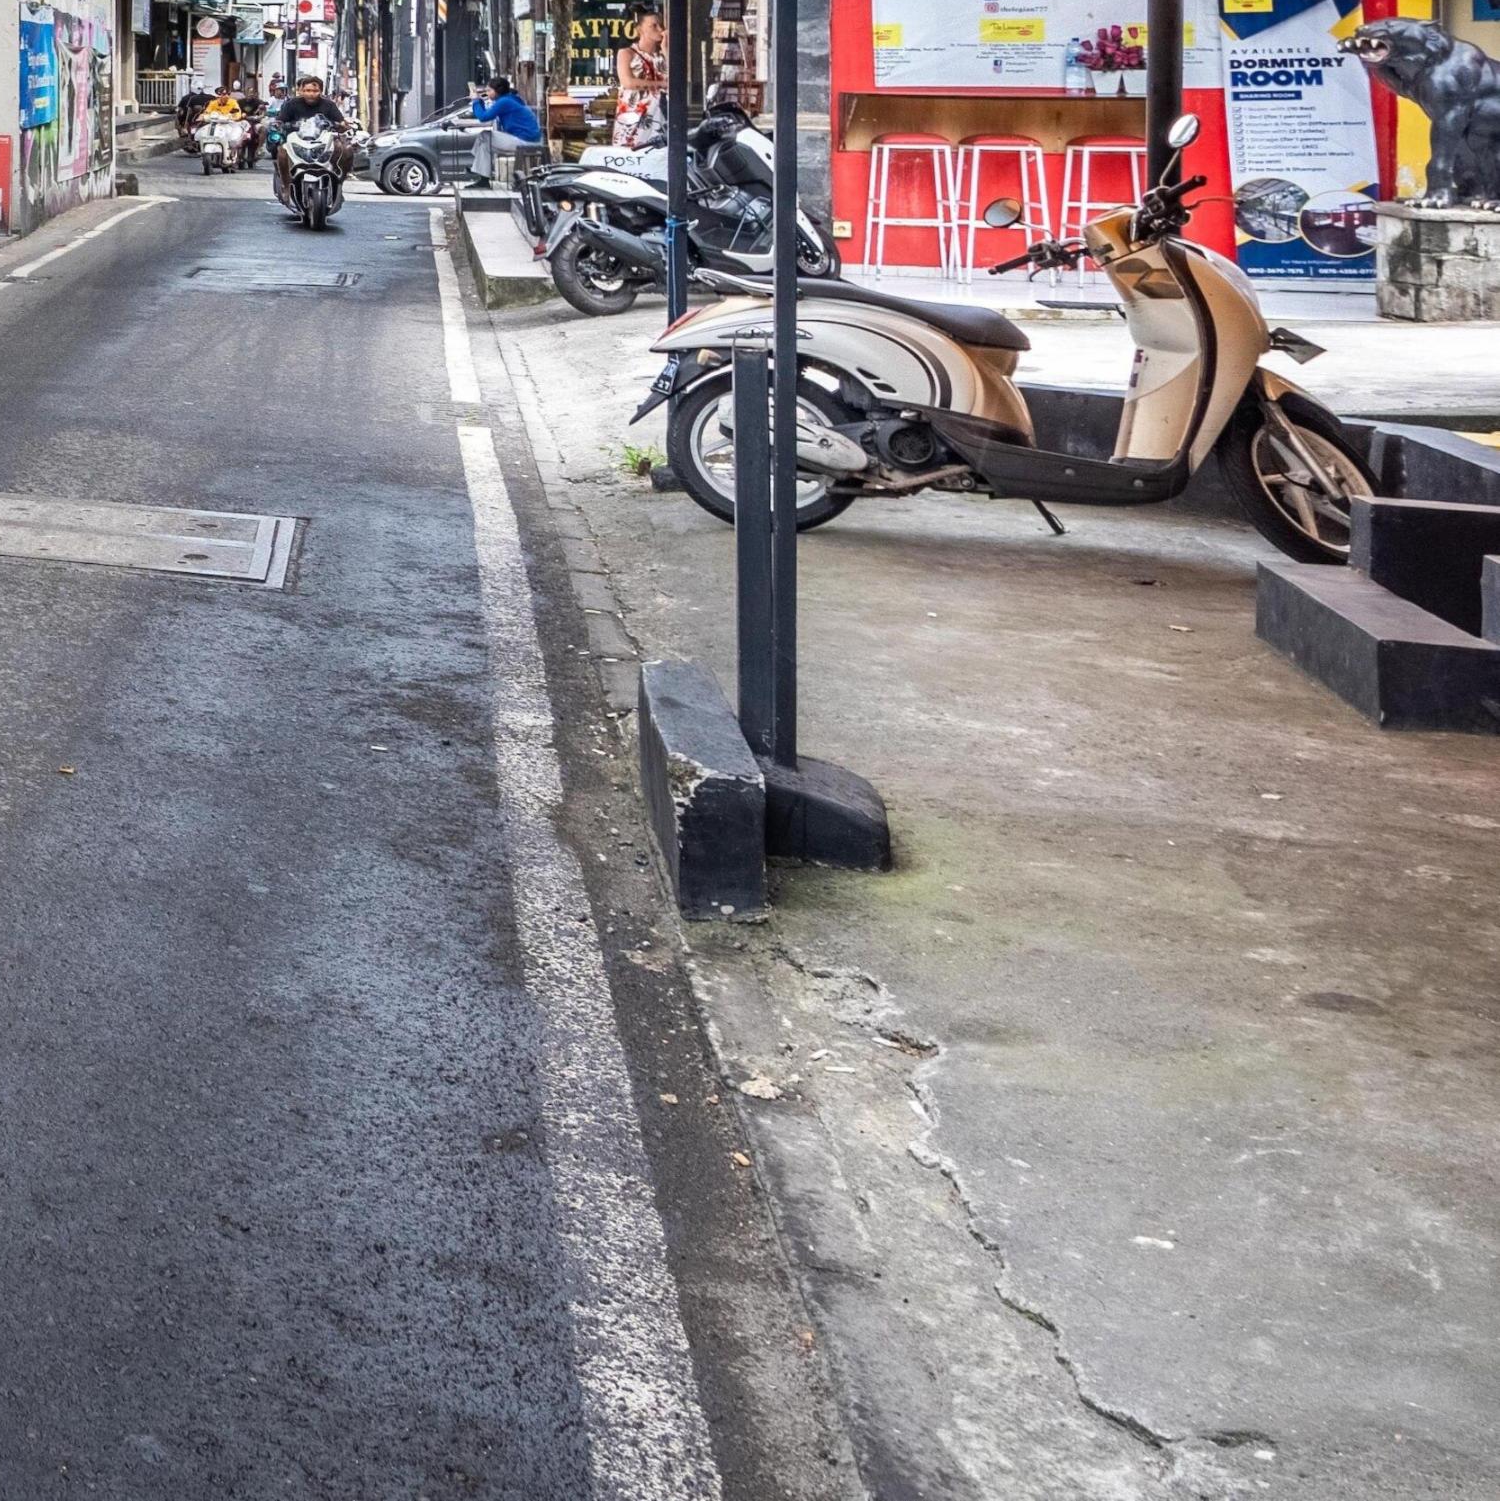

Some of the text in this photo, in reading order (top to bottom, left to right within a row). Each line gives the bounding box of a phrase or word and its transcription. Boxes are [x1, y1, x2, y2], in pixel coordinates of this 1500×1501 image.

[1230, 47, 1311, 55] AVAILABLE
[1230, 57, 1346, 70] DORMITORY
[1230, 69, 1324, 87] ROOM
[604, 155, 645, 167] POST
